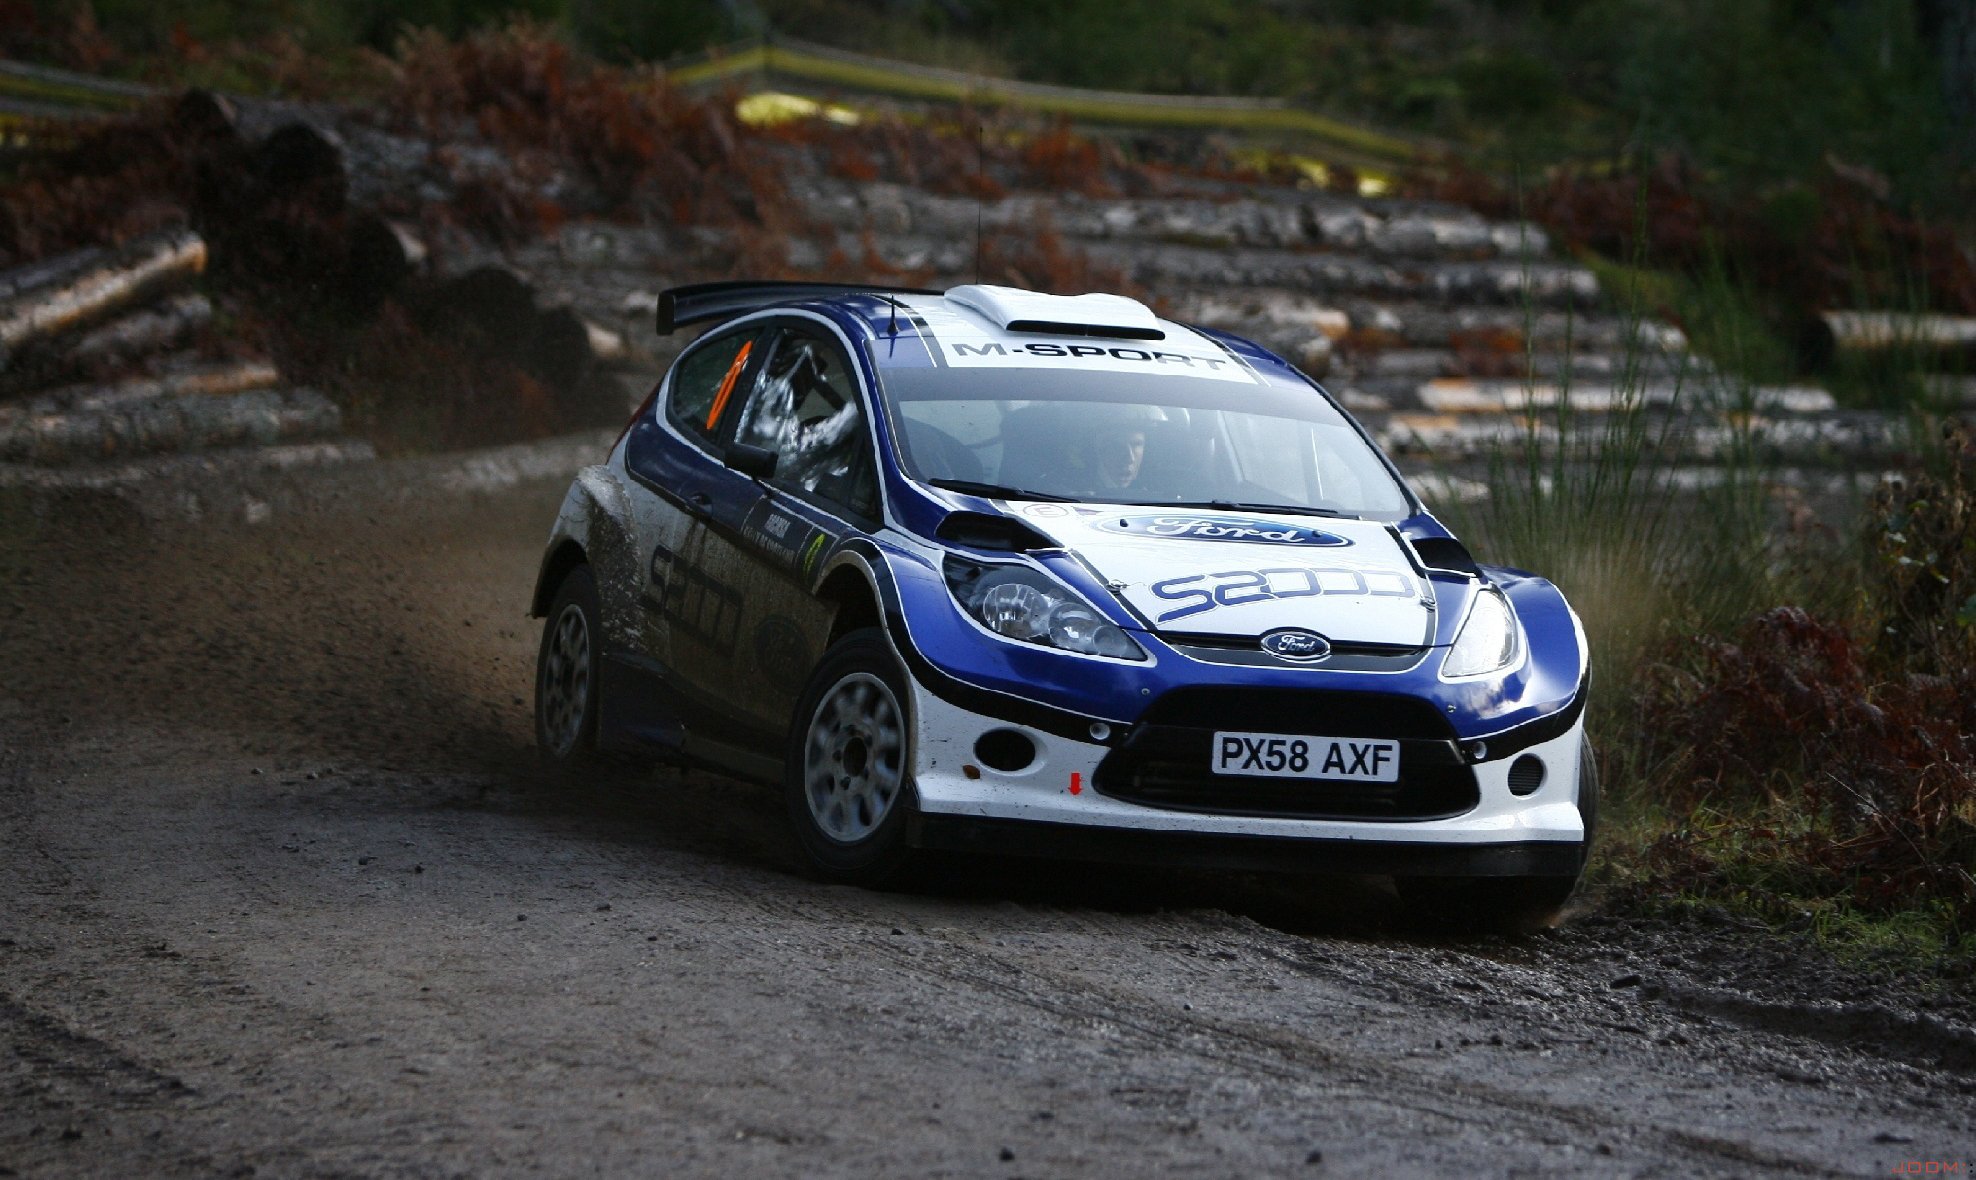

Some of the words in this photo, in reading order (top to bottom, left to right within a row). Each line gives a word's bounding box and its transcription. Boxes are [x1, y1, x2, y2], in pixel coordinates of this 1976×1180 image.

[951, 342, 1226, 370] M-SPORT
[1147, 516, 1305, 543] Ford
[1150, 569, 1414, 622] S2000
[1278, 635, 1315, 651] Ford
[1221, 737, 1309, 772] PX58
[1321, 743, 1393, 776] AXF
